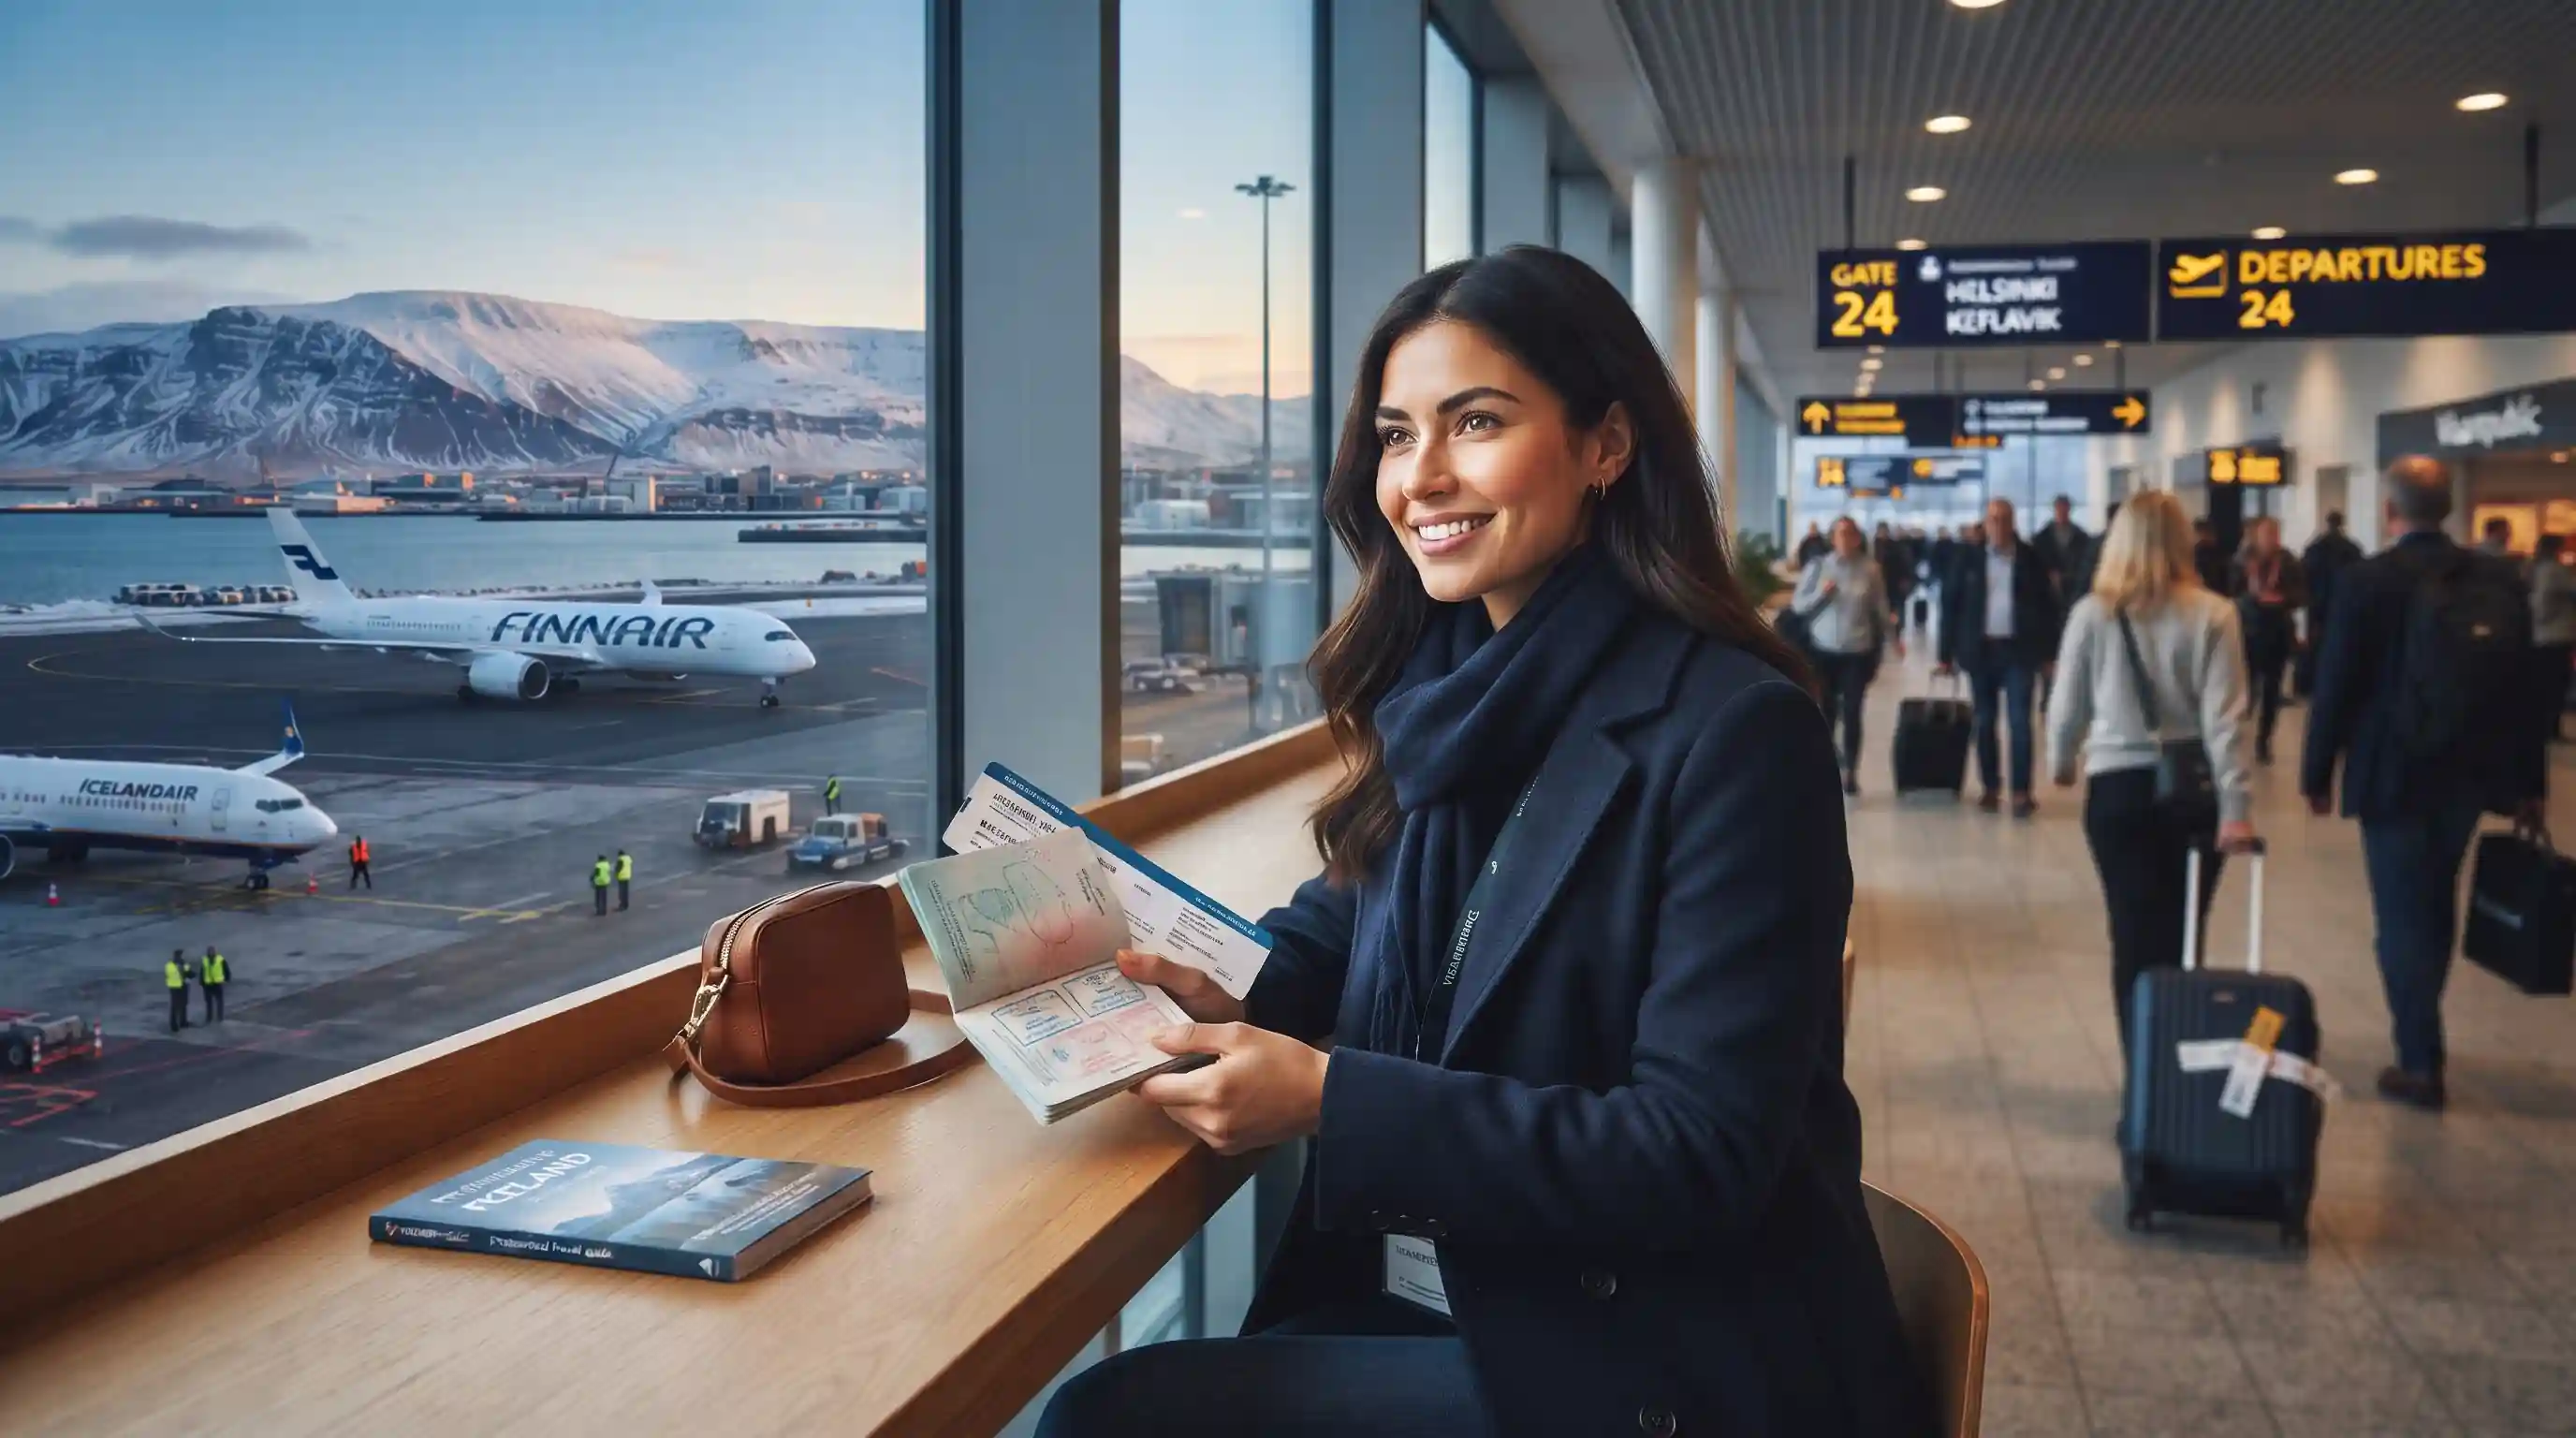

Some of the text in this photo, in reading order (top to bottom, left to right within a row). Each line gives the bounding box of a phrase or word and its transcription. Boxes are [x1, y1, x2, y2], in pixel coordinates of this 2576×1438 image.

[1831, 260, 1898, 286] GATE
[2239, 244, 2486, 284] DEPARTURES
[1832, 290, 1899, 337] 24
[2239, 289, 2294, 329] 24
[490, 611, 715, 649] FINNAIR
[79, 778, 198, 801] ICELANDAIR
